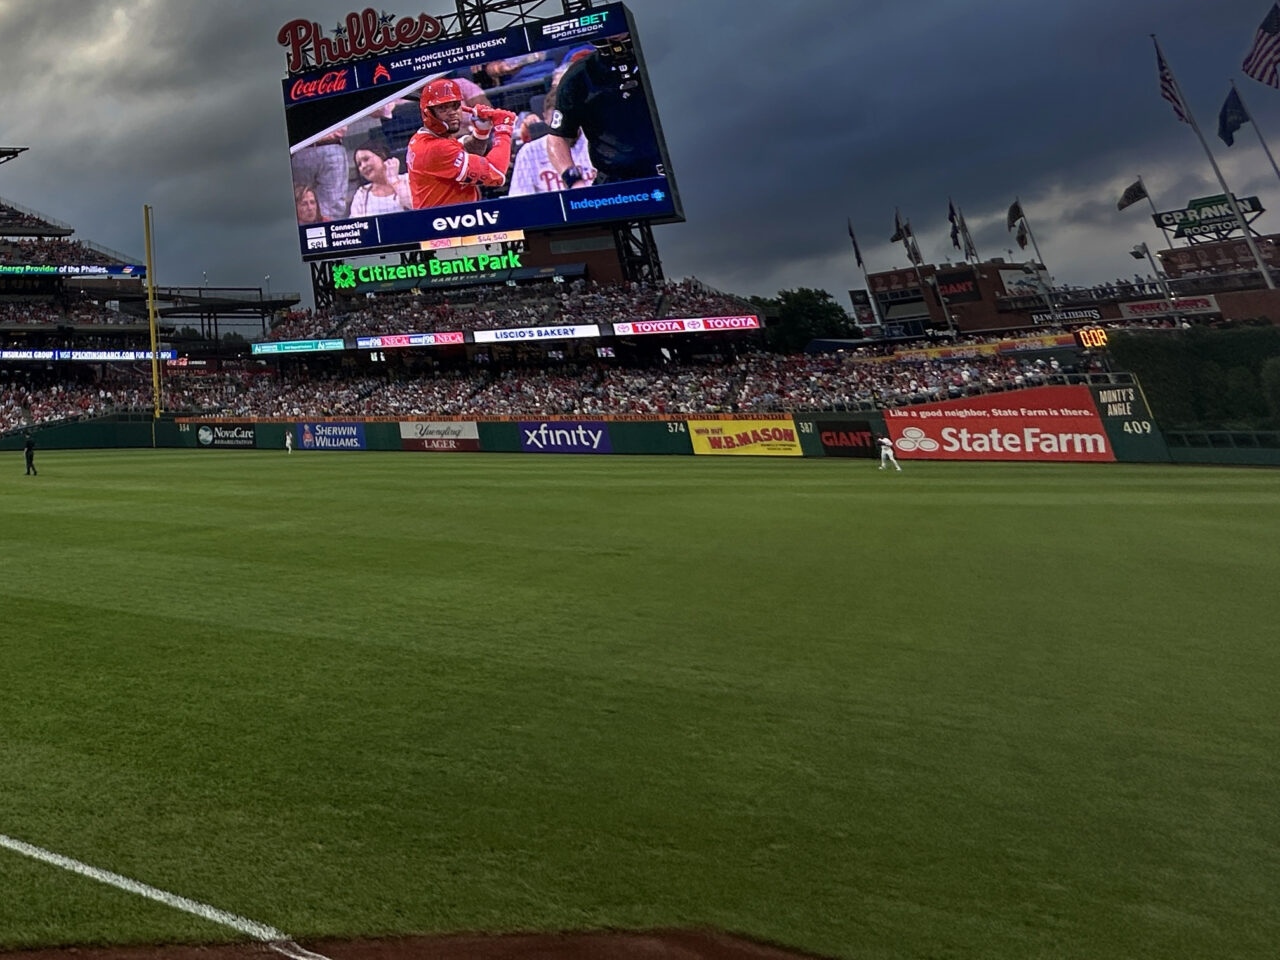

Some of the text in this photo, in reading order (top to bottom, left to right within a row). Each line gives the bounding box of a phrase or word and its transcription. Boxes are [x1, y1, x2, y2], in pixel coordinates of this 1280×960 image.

[551, 23, 604, 39] SPORTSBOOK
[277, 7, 442, 72] Phillies
[390, 37, 507, 69] SALTZ MONGELUZZI BENDESKY
[413, 50, 486, 71] INJURY LAWYERS
[290, 69, 349, 100] Coca-Cola
[570, 192, 649, 210] Independence
[1185, 200, 1253, 221] RANKN
[330, 222, 369, 231] Connecting
[432, 209, 500, 231] evolv
[331, 229, 360, 239] financial
[332, 238, 362, 247] services.
[25, 265, 57, 273] Provider
[58, 265, 67, 273] of
[68, 265, 80, 273] the
[358, 250, 522, 283] Citizens Bank Park
[635, 316, 757, 332] TOYOTA TOYOTA
[384, 337, 407, 345] NECA
[437, 334, 460, 343] NECA
[494, 327, 575, 339] LISCIO'S BAKERY
[2, 351, 33, 359] INSURANCE
[34, 351, 54, 359] GROUP
[72, 351, 135, 360] SPECHTINSURANCE.COM
[1099, 388, 1135, 403] MONTY'S
[889, 408, 909, 418] Like
[919, 408, 942, 420] good
[944, 408, 990, 420] neighbor,
[991, 407, 1019, 417] State
[1020, 407, 1048, 417] Farm
[1049, 407, 1059, 417] is
[1060, 407, 1094, 417] there.
[1107, 402, 1132, 417] ANGLE
[214, 427, 254, 438] NovaCare
[315, 424, 357, 435] SHERWIN
[415, 422, 465, 438] Yuengling
[667, 422, 686, 433] 374
[799, 422, 814, 434] 387
[1123, 421, 1152, 434] 409
[524, 423, 602, 449] xfinity
[822, 431, 871, 447] GIANT
[424, 439, 457, 449] LAGER
